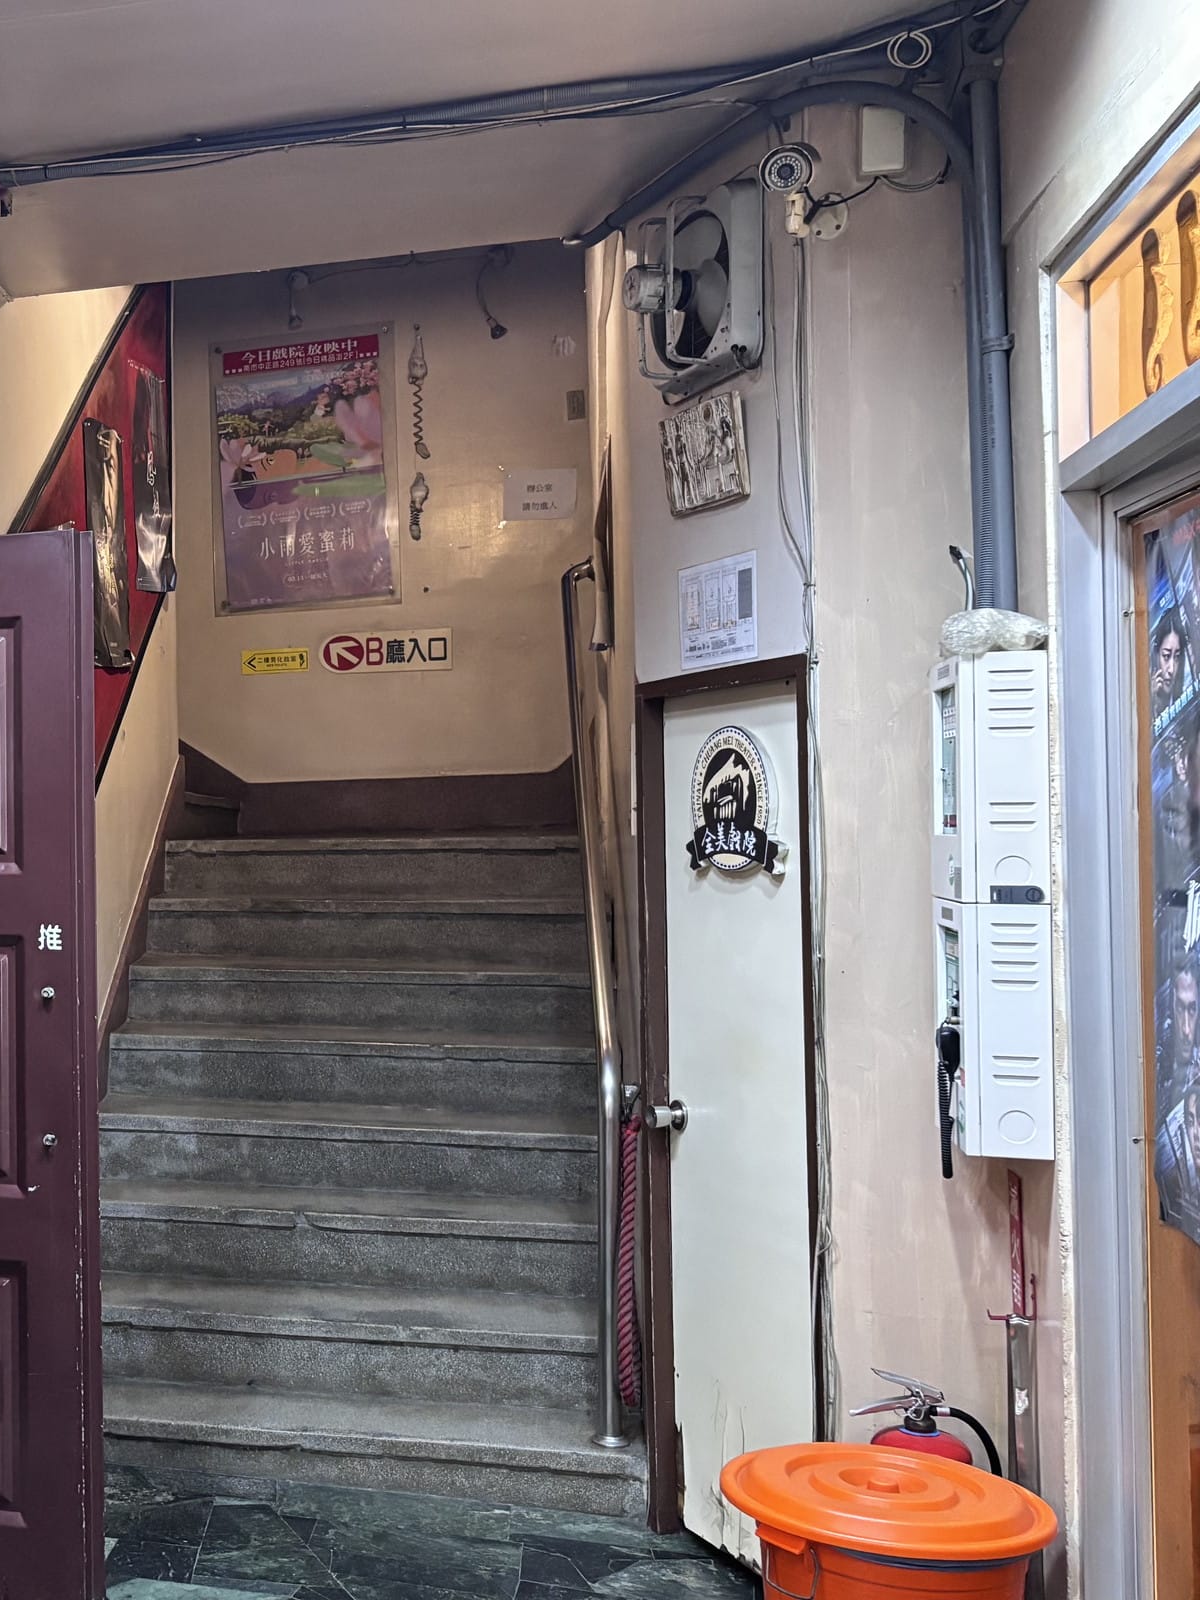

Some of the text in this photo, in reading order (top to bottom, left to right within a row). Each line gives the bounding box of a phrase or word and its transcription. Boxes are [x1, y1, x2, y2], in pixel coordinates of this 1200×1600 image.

[366, 637, 448, 666] B廳入口
[723, 736, 734, 746] MEI
[734, 738, 756, 767] THEATER
[755, 772, 764, 803] SINCE
[701, 821, 758, 857] 全美戲院
[38, 923, 62, 950] 推
